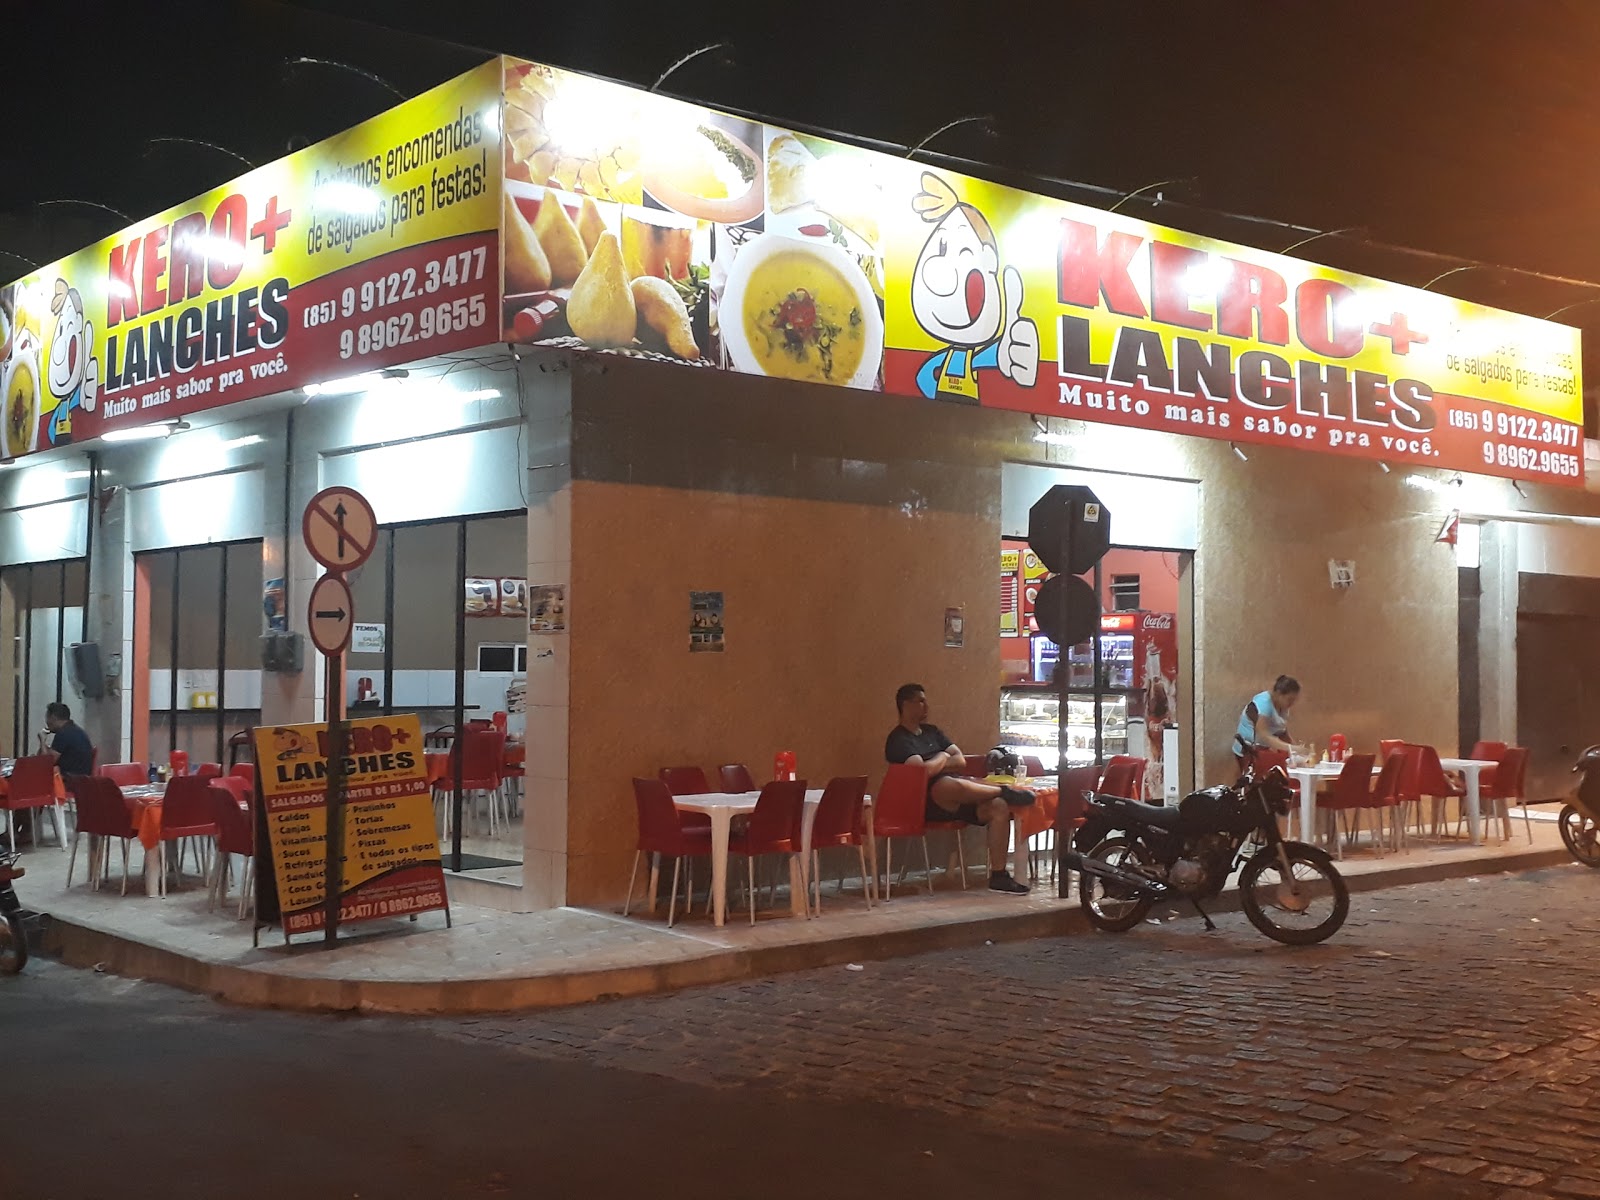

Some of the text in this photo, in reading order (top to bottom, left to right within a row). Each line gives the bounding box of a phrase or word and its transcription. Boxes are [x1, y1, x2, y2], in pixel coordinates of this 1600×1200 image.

[386, 106, 482, 179] encomendas
[308, 213, 323, 255] de
[391, 184, 425, 238] para
[431, 148, 486, 211] festas!
[304, 246, 487, 328] (85) 9 9122.3477
[104, 277, 290, 395] LANCHES
[339, 293, 487, 359] 9 8962.9655
[103, 352, 289, 419] Muito mais sabor pra você.
[1057, 314, 1438, 433] LANCHES
[1464, 355, 1513, 384] salgados
[1516, 368, 1540, 390] paa
[1058, 382, 1440, 458] Muito mais sabor pra você.
[1449, 408, 1579, 448] (85) 9 9122.3477
[1483, 441, 1579, 477] 9 8962.9655
[271, 793, 325, 808] SALGADOS
[375, 786, 387, 795] DE
[278, 812, 310, 822] Caldos
[280, 824, 311, 835] Canjas
[357, 823, 411, 837] Sobremesas
[283, 849, 310, 859] Sucos
[362, 863, 373, 871] de
[369, 848, 395, 858] todos
[288, 885, 312, 894] Coco
